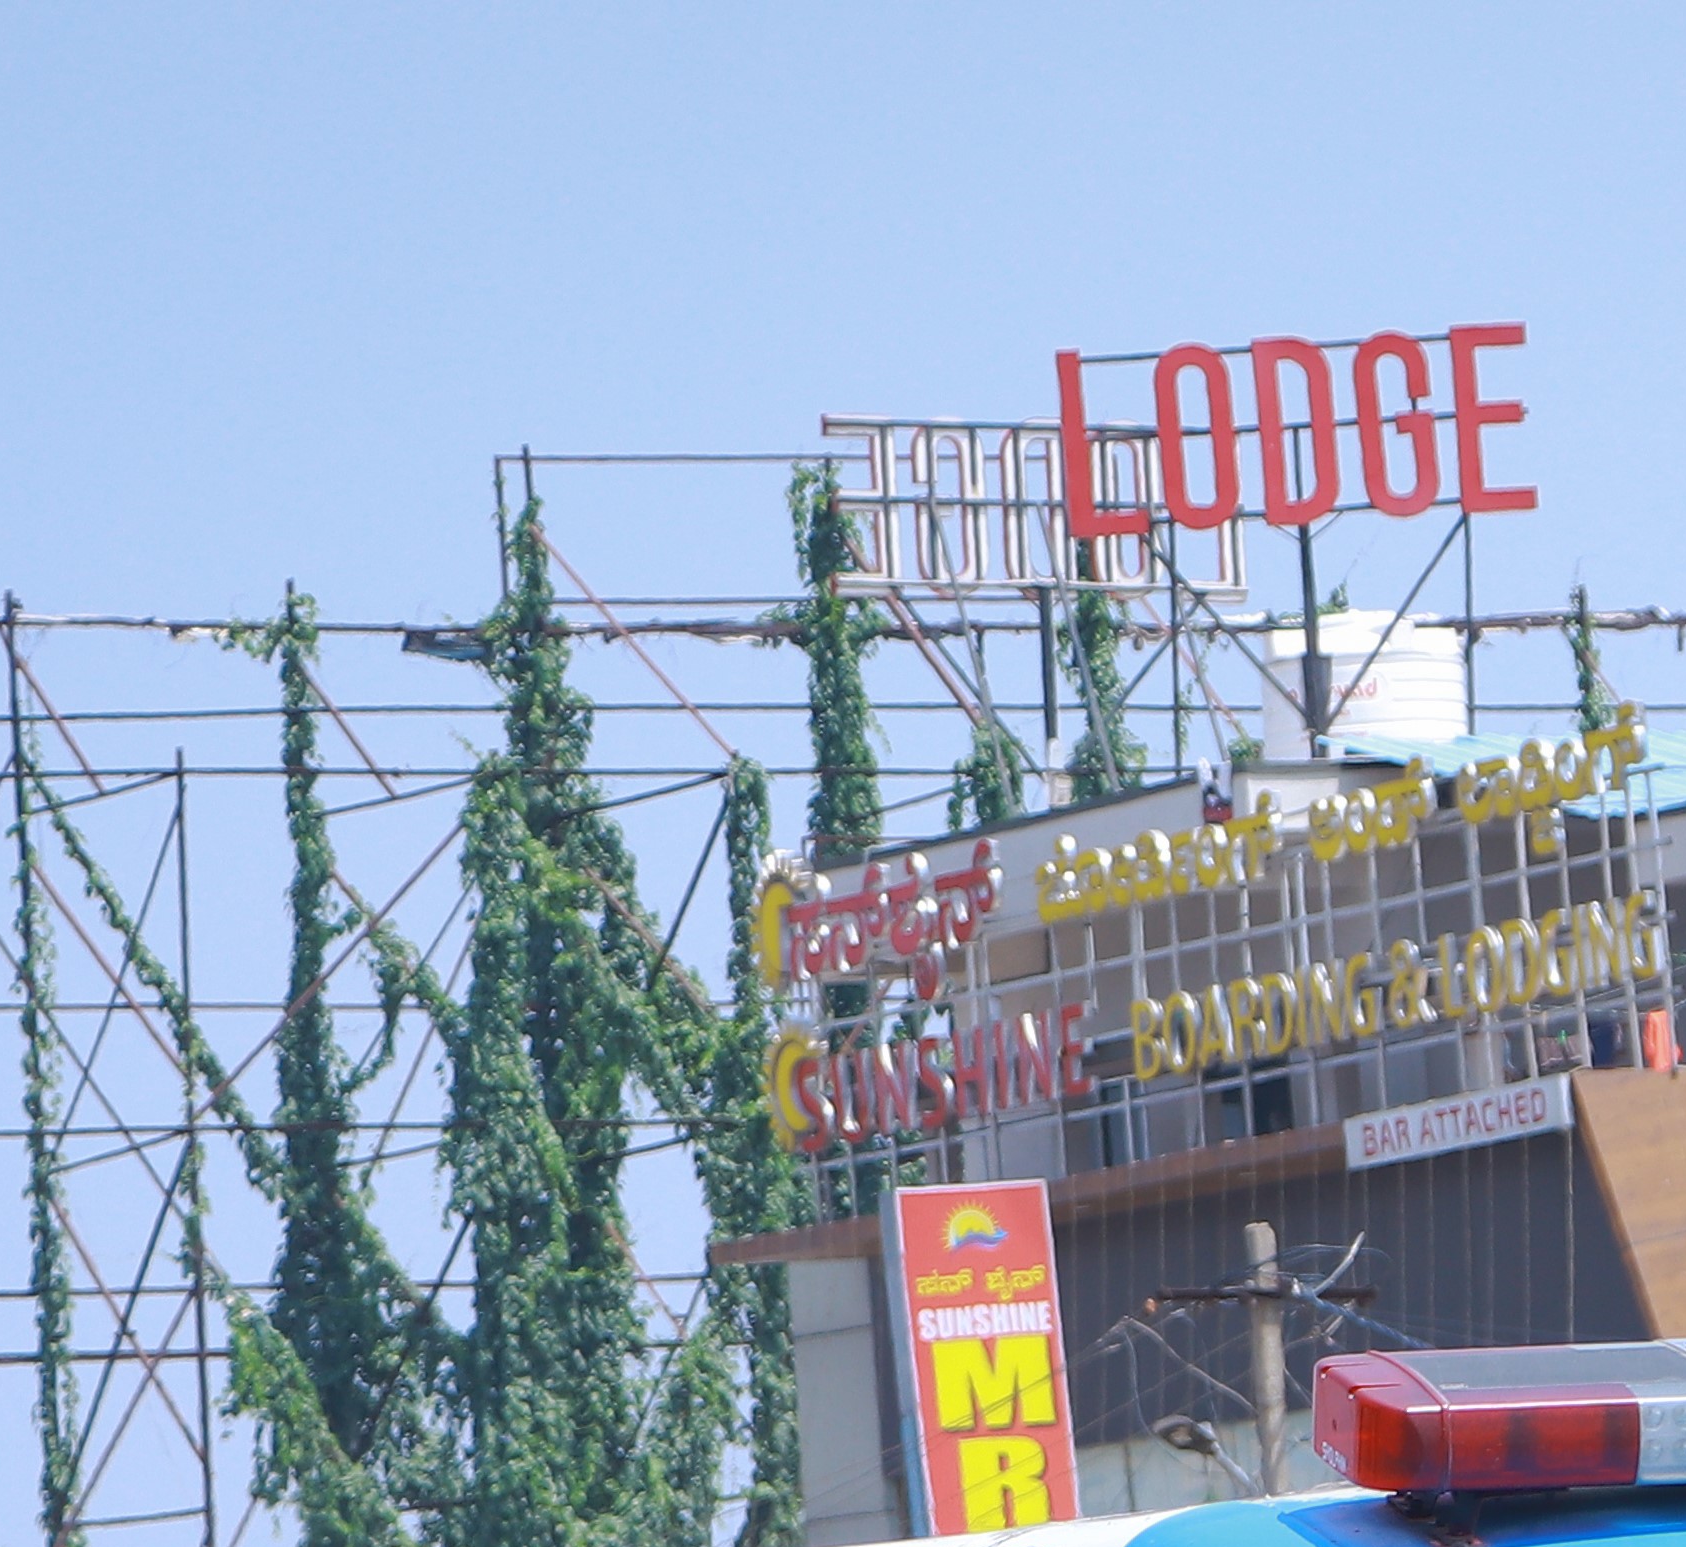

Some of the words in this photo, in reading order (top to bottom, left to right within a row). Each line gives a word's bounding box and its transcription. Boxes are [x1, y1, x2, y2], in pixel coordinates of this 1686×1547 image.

[1056, 322, 1538, 538] LODGE
[796, 1004, 1094, 1150] SUNSHINE
[1130, 952, 1383, 1082] BOARDING
[1390, 938, 1439, 1029] &
[1438, 890, 1660, 1019] LODGING
[1362, 1116, 1411, 1156] BAR
[1420, 1087, 1549, 1145] ATTACHED
[917, 1301, 1053, 1343] SUNSHINE
